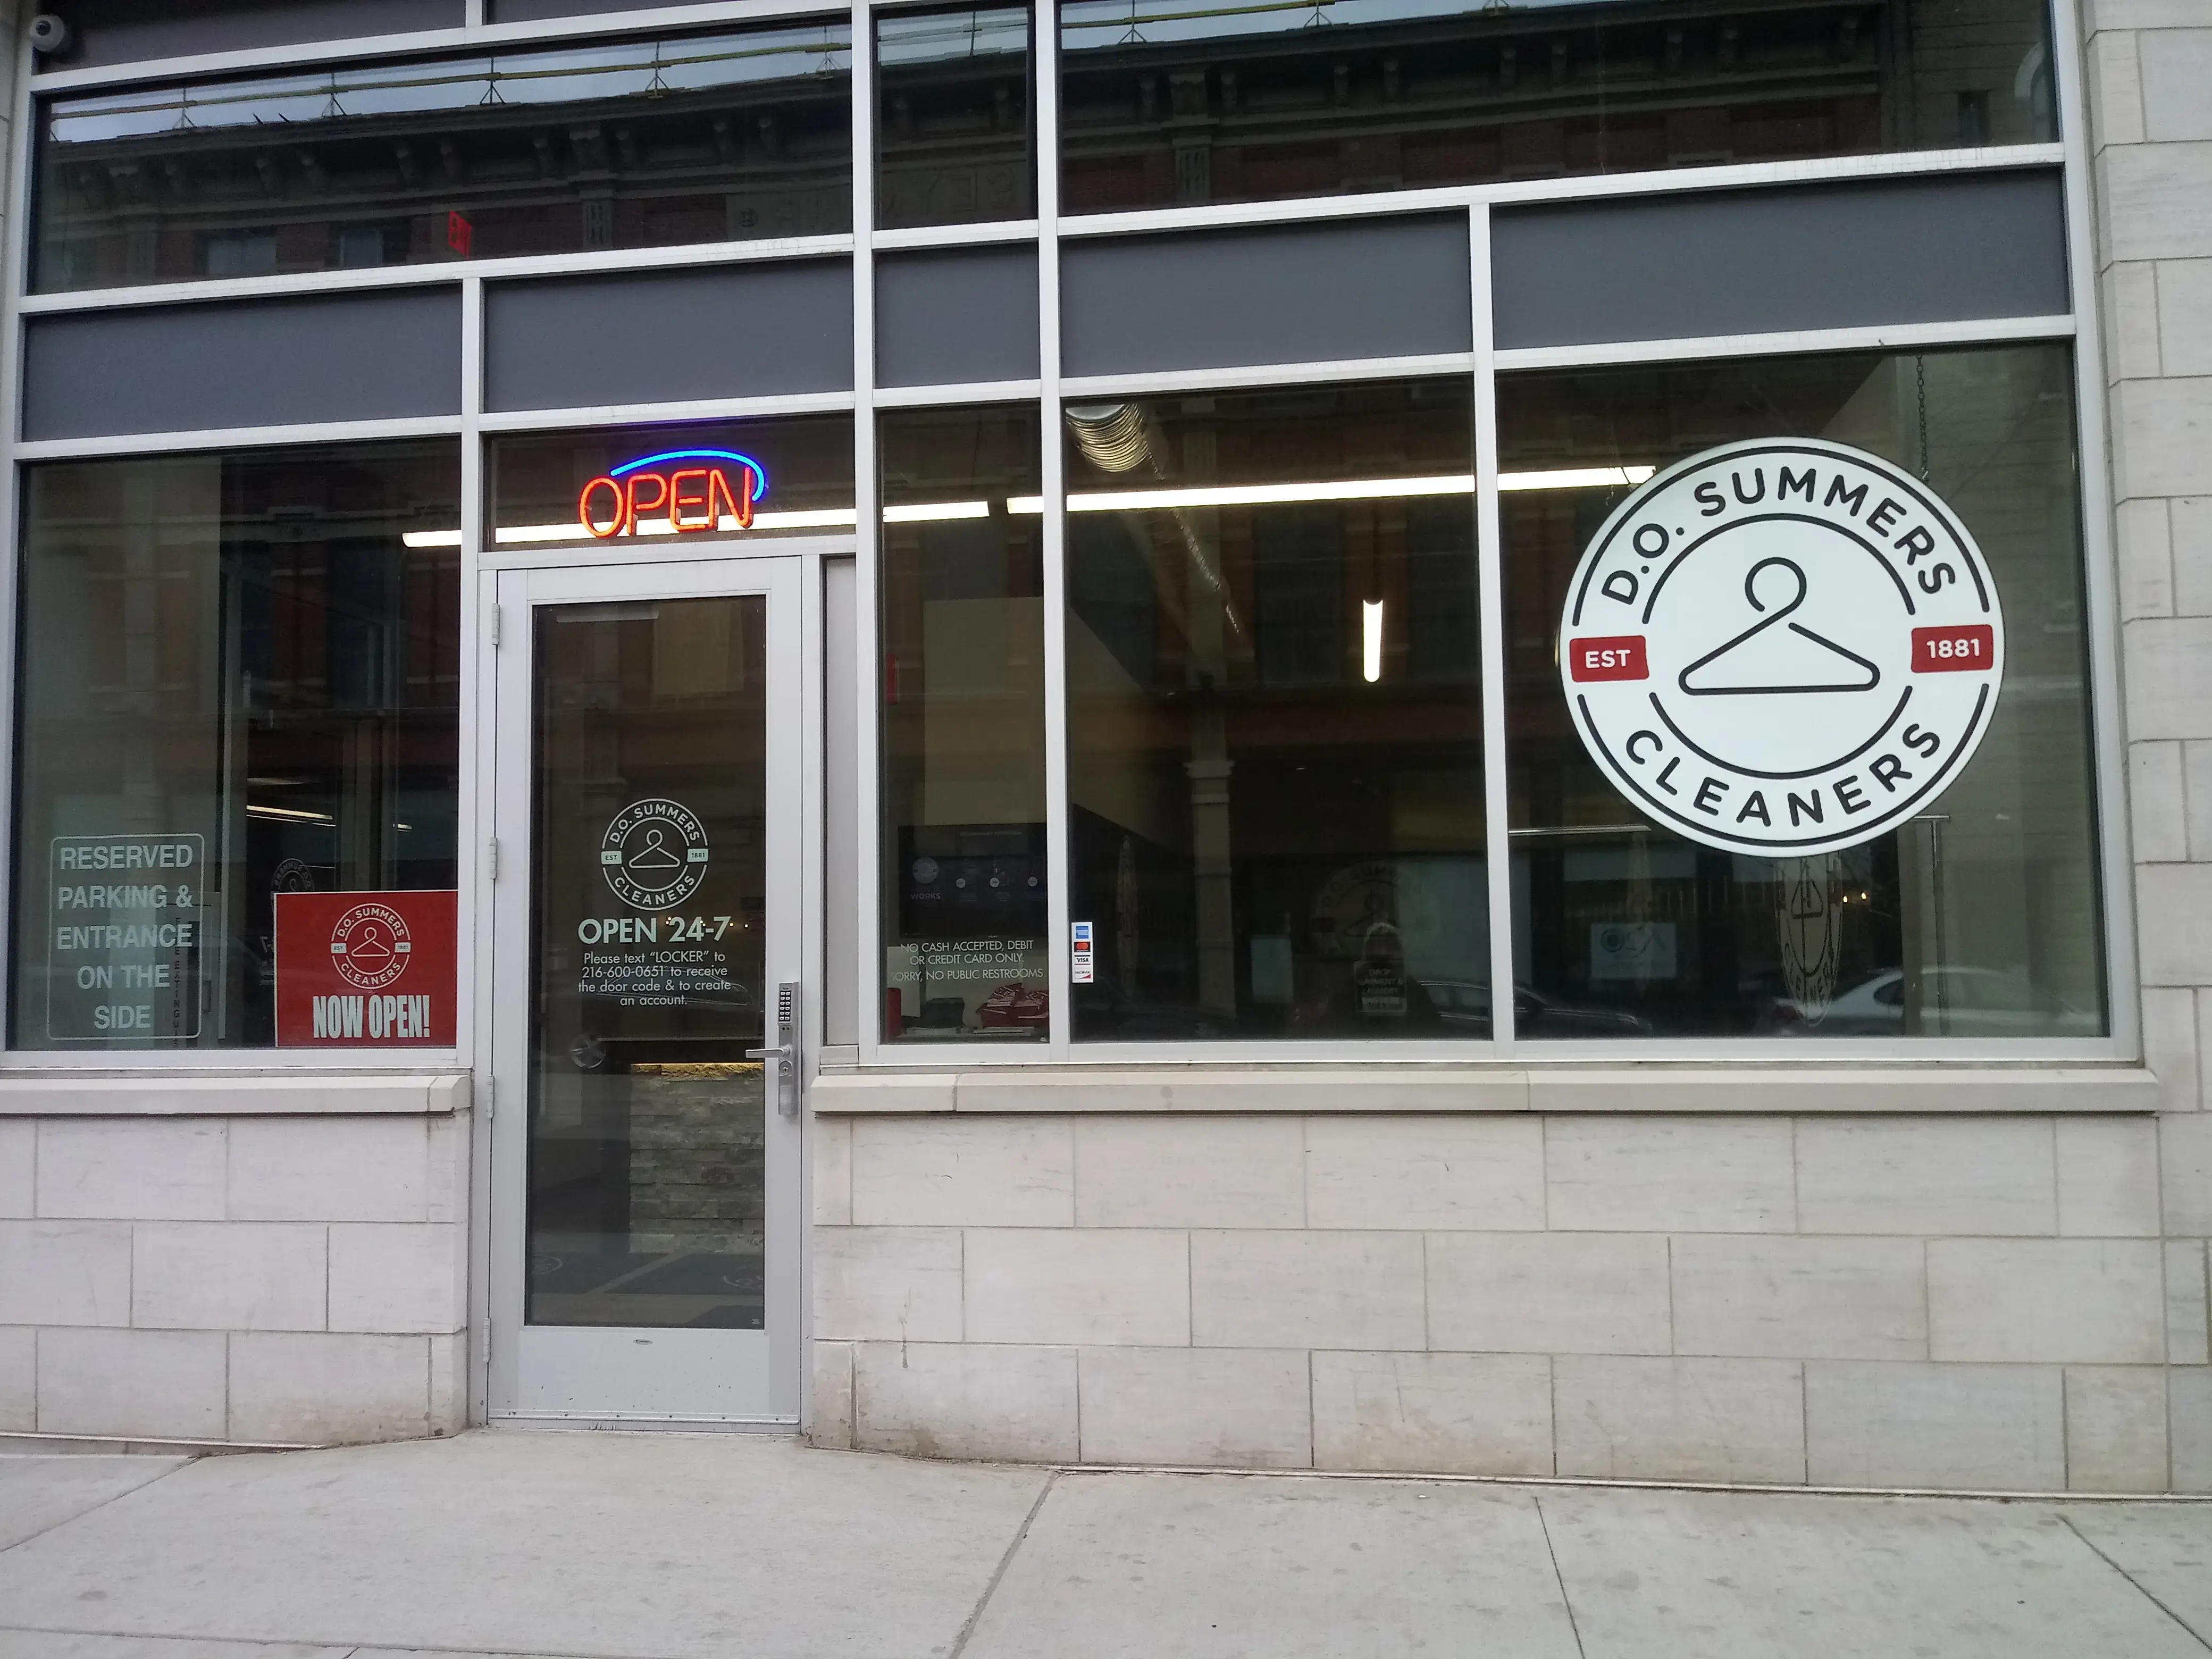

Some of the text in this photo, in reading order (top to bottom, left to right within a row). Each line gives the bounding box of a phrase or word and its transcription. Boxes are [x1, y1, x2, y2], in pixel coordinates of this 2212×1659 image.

[579, 466, 755, 538] OPEN
[1601, 466, 1956, 605] D.O. SUMMERS
[1585, 649, 1631, 669] EST
[1926, 638, 1980, 659] 1881
[1626, 723, 1940, 827] CLEANERS
[609, 803, 700, 843] D.O. SUMMERS
[60, 844, 193, 870] RESERVED
[57, 884, 193, 909] PARKING &
[614, 875, 695, 905] CLEANERS
[337, 908, 405, 937] D.O. SUMMERS
[578, 916, 732, 944] OPEN 24-7
[57, 924, 193, 950] ENTRANCE
[900, 940, 1034, 953] NO CASH ACCEPTED, DEBIT
[584, 952, 621, 964] Please
[624, 952, 645, 963] text
[714, 951, 725, 962] to
[910, 953, 1024, 965] OR CREDIT CARD ONLY.
[77, 964, 170, 989] ON THE
[341, 962, 400, 985] CLEANERS
[582, 966, 727, 978] 216-600-0651 to receive
[889, 968, 1043, 983] SORRY, NO PUBLIC RESTROOMS
[578, 980, 731, 993] the door code & to create
[620, 995, 688, 1006] an account.
[94, 1005, 151, 1029] SIDE
[313, 994, 430, 1038] NOW OPEN!
